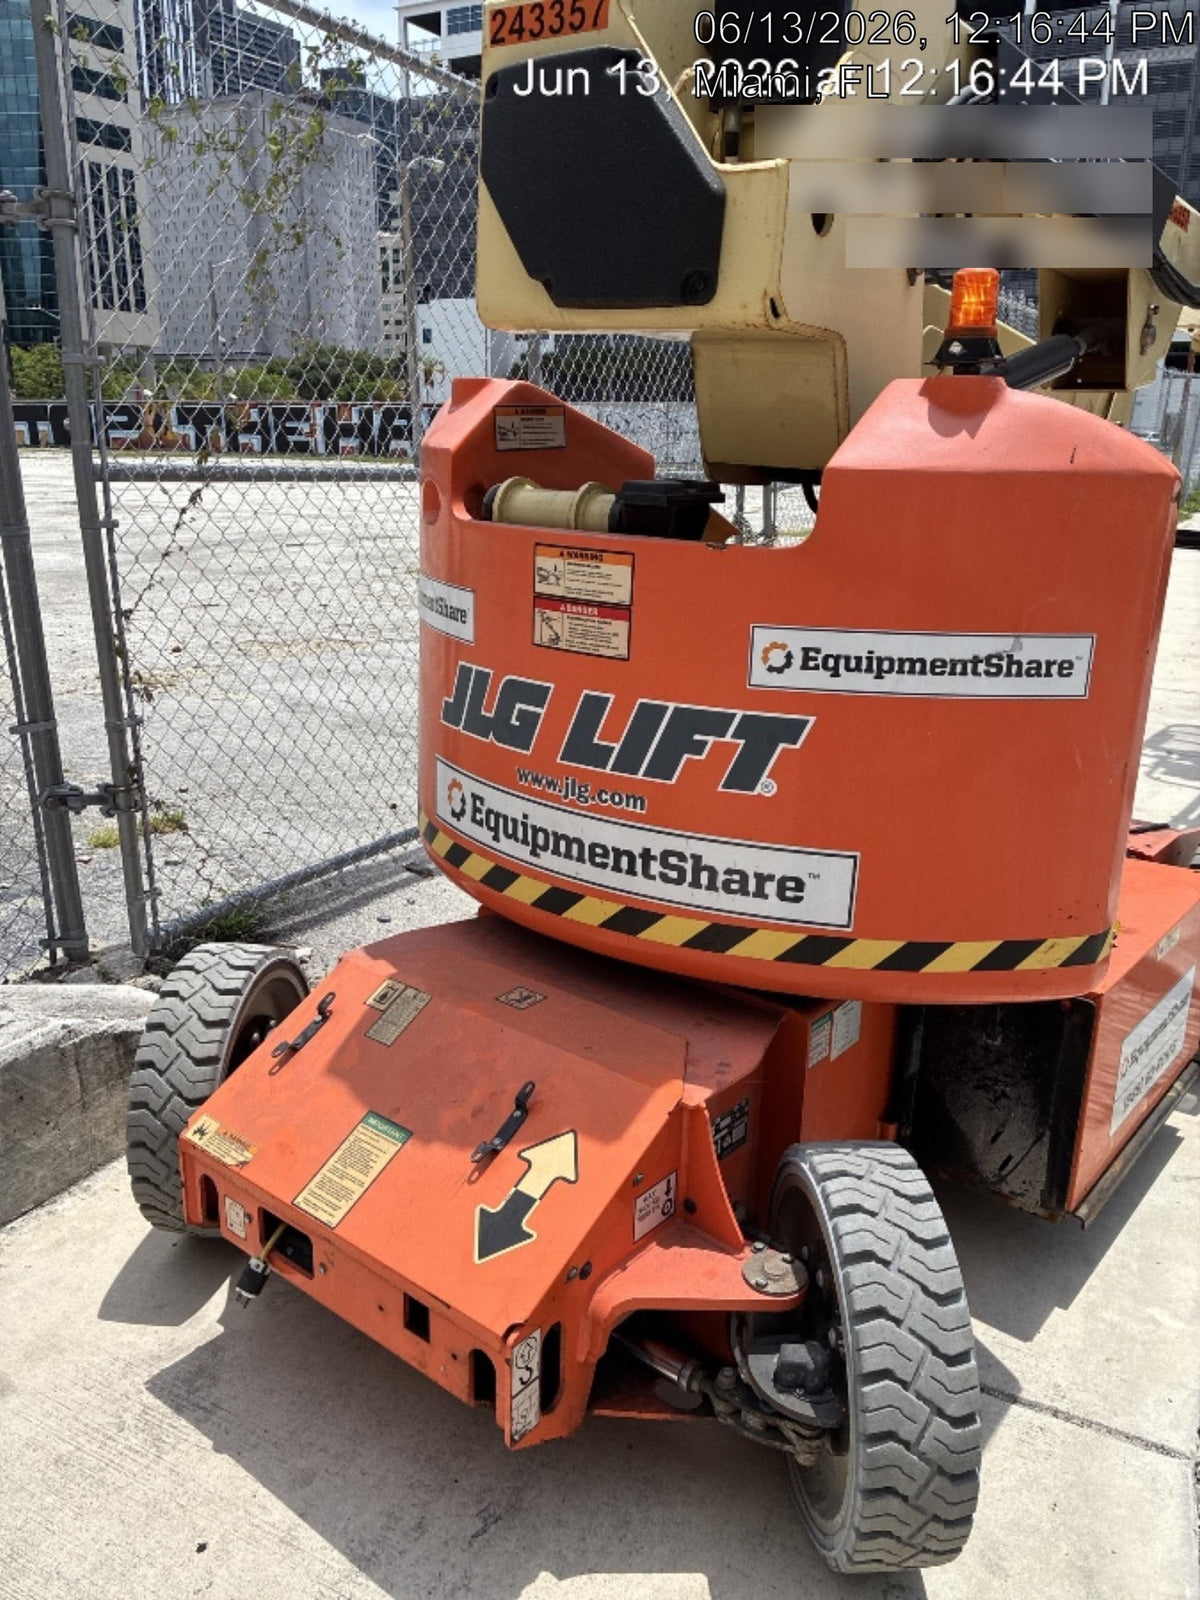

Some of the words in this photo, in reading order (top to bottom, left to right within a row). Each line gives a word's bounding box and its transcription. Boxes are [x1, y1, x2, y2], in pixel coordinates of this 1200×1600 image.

[489, 0, 605, 45] 243357
[799, 645, 1076, 680] EquipmentShare
[441, 660, 555, 755] JLG
[556, 689, 817, 795] LIFT
[515, 766, 648, 814] www.jlg.com
[469, 791, 807, 904] EquipmentShare
